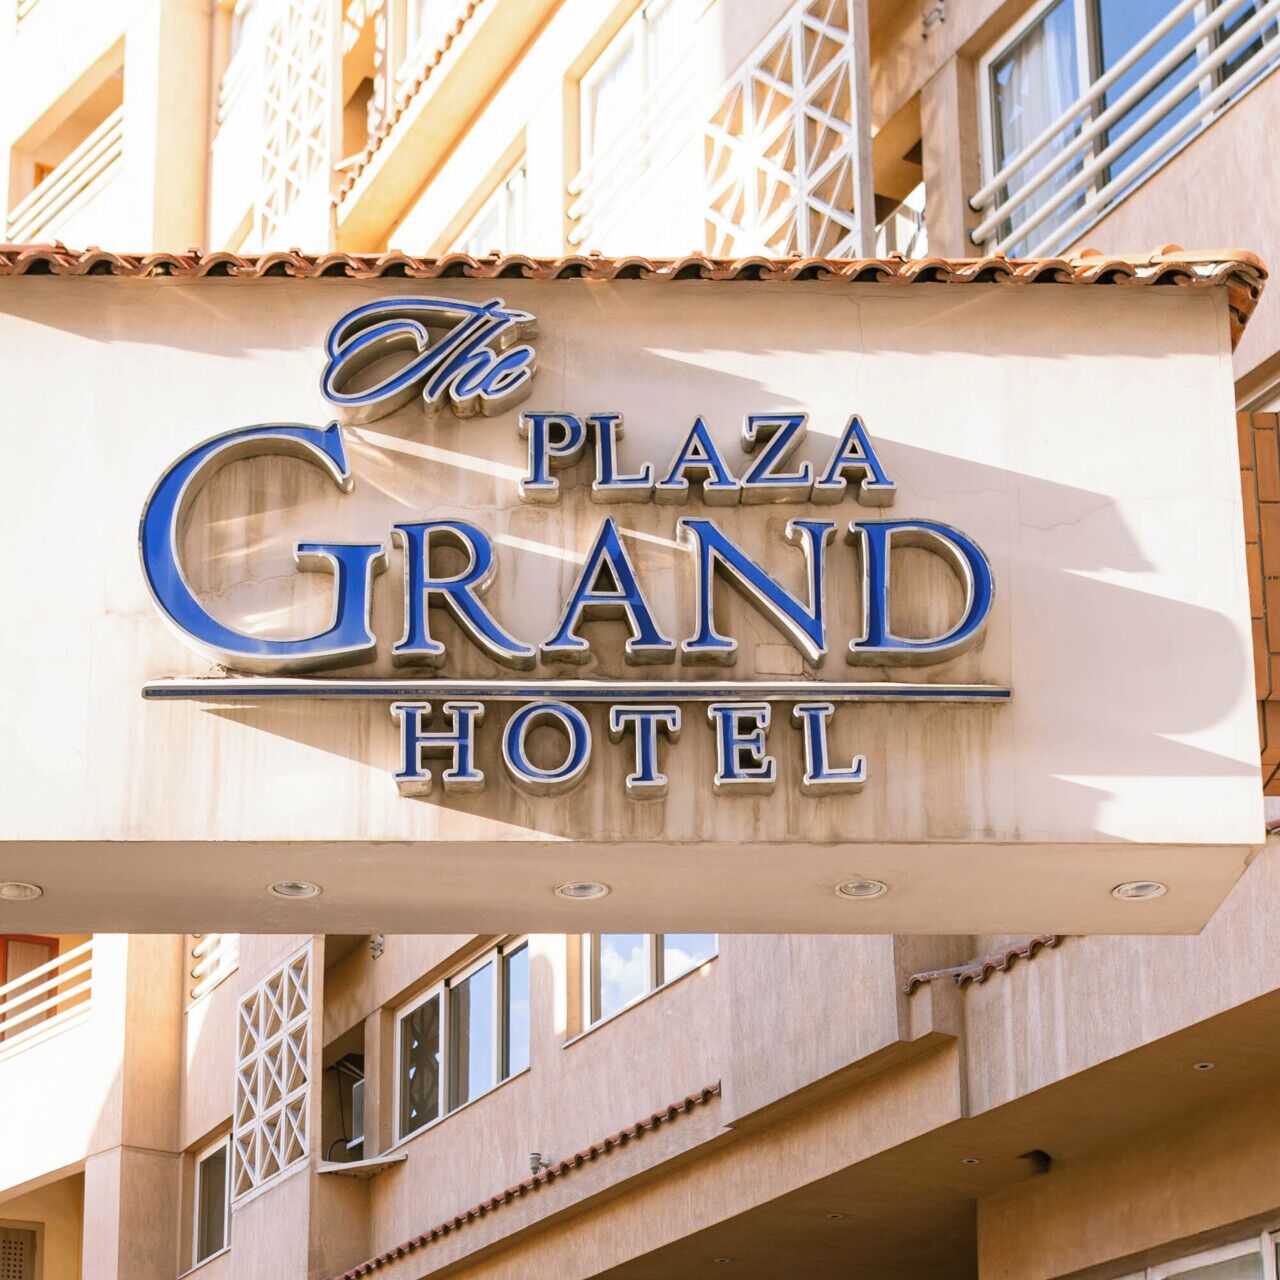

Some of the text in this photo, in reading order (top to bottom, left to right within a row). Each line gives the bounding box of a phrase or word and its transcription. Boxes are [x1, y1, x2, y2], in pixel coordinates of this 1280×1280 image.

[319, 295, 538, 415] The
[519, 411, 899, 502] PLAZA
[139, 420, 997, 671] GRAND
[391, 701, 868, 797] HOTEL
